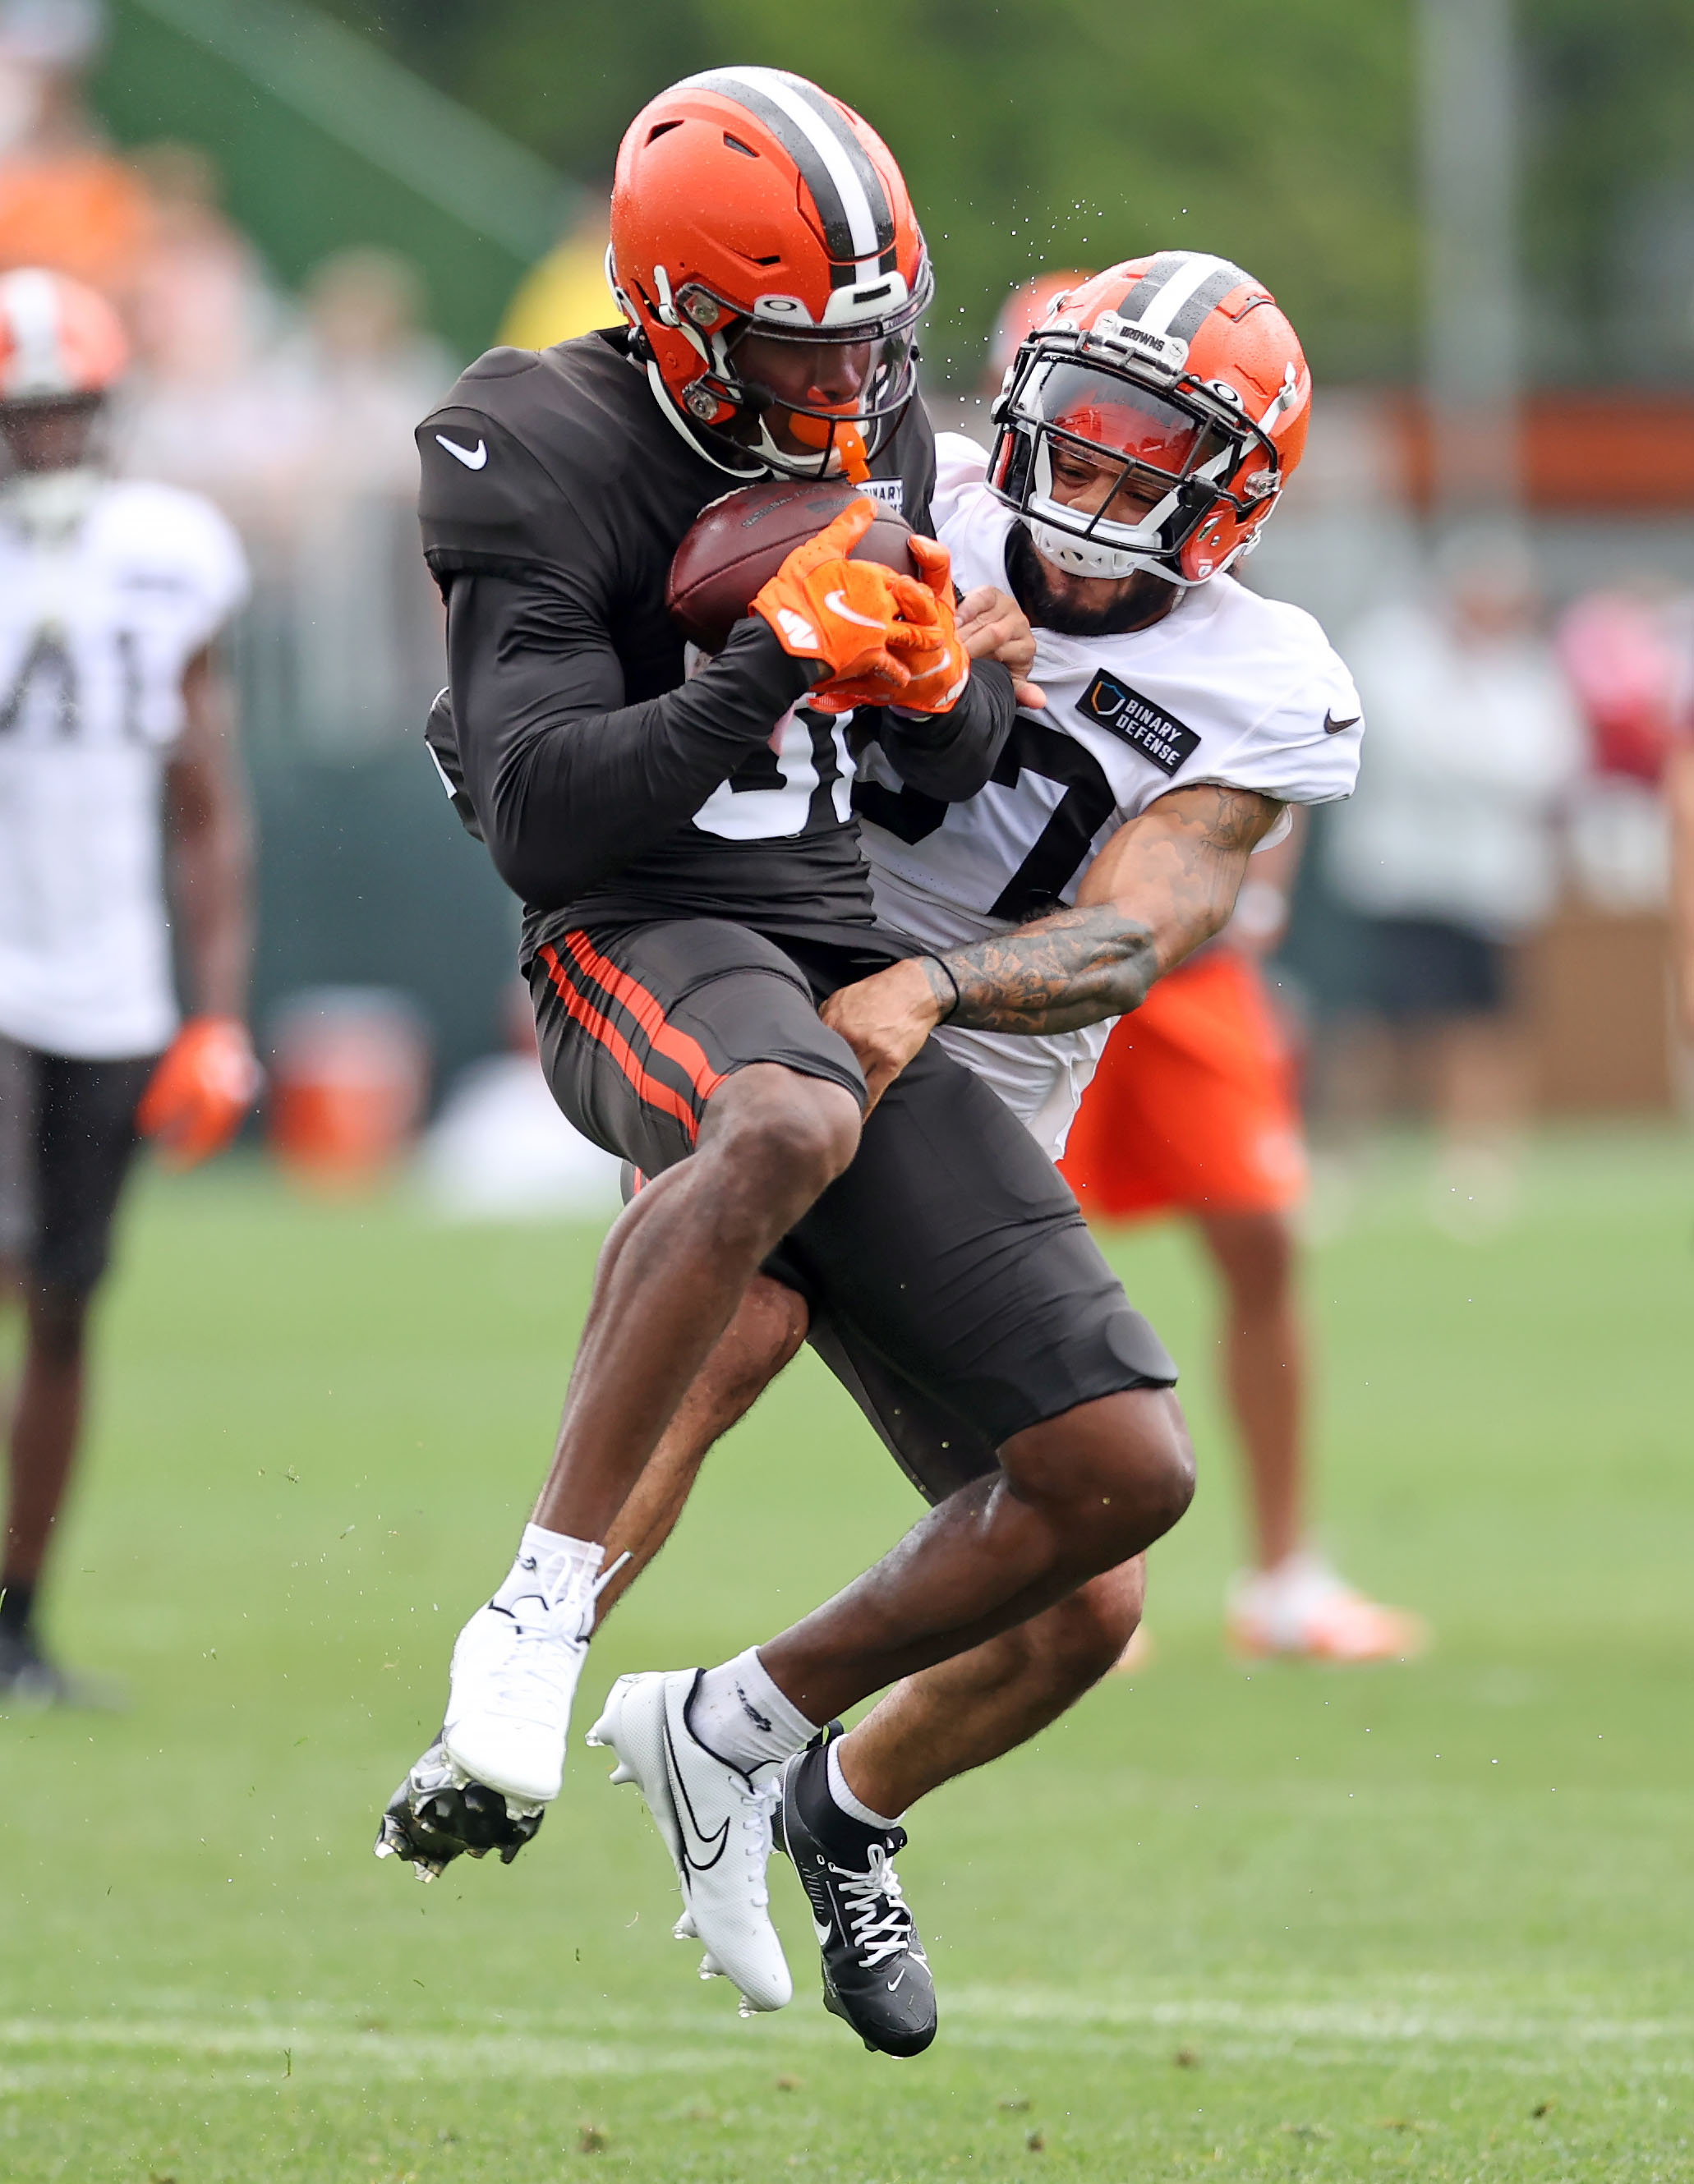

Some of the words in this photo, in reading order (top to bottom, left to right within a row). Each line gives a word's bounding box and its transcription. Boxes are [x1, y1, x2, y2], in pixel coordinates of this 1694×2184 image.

[1120, 326, 1165, 352] BROWNS
[1115, 714, 1181, 766] DEFENSE
[1125, 699, 1181, 743] BINARY
